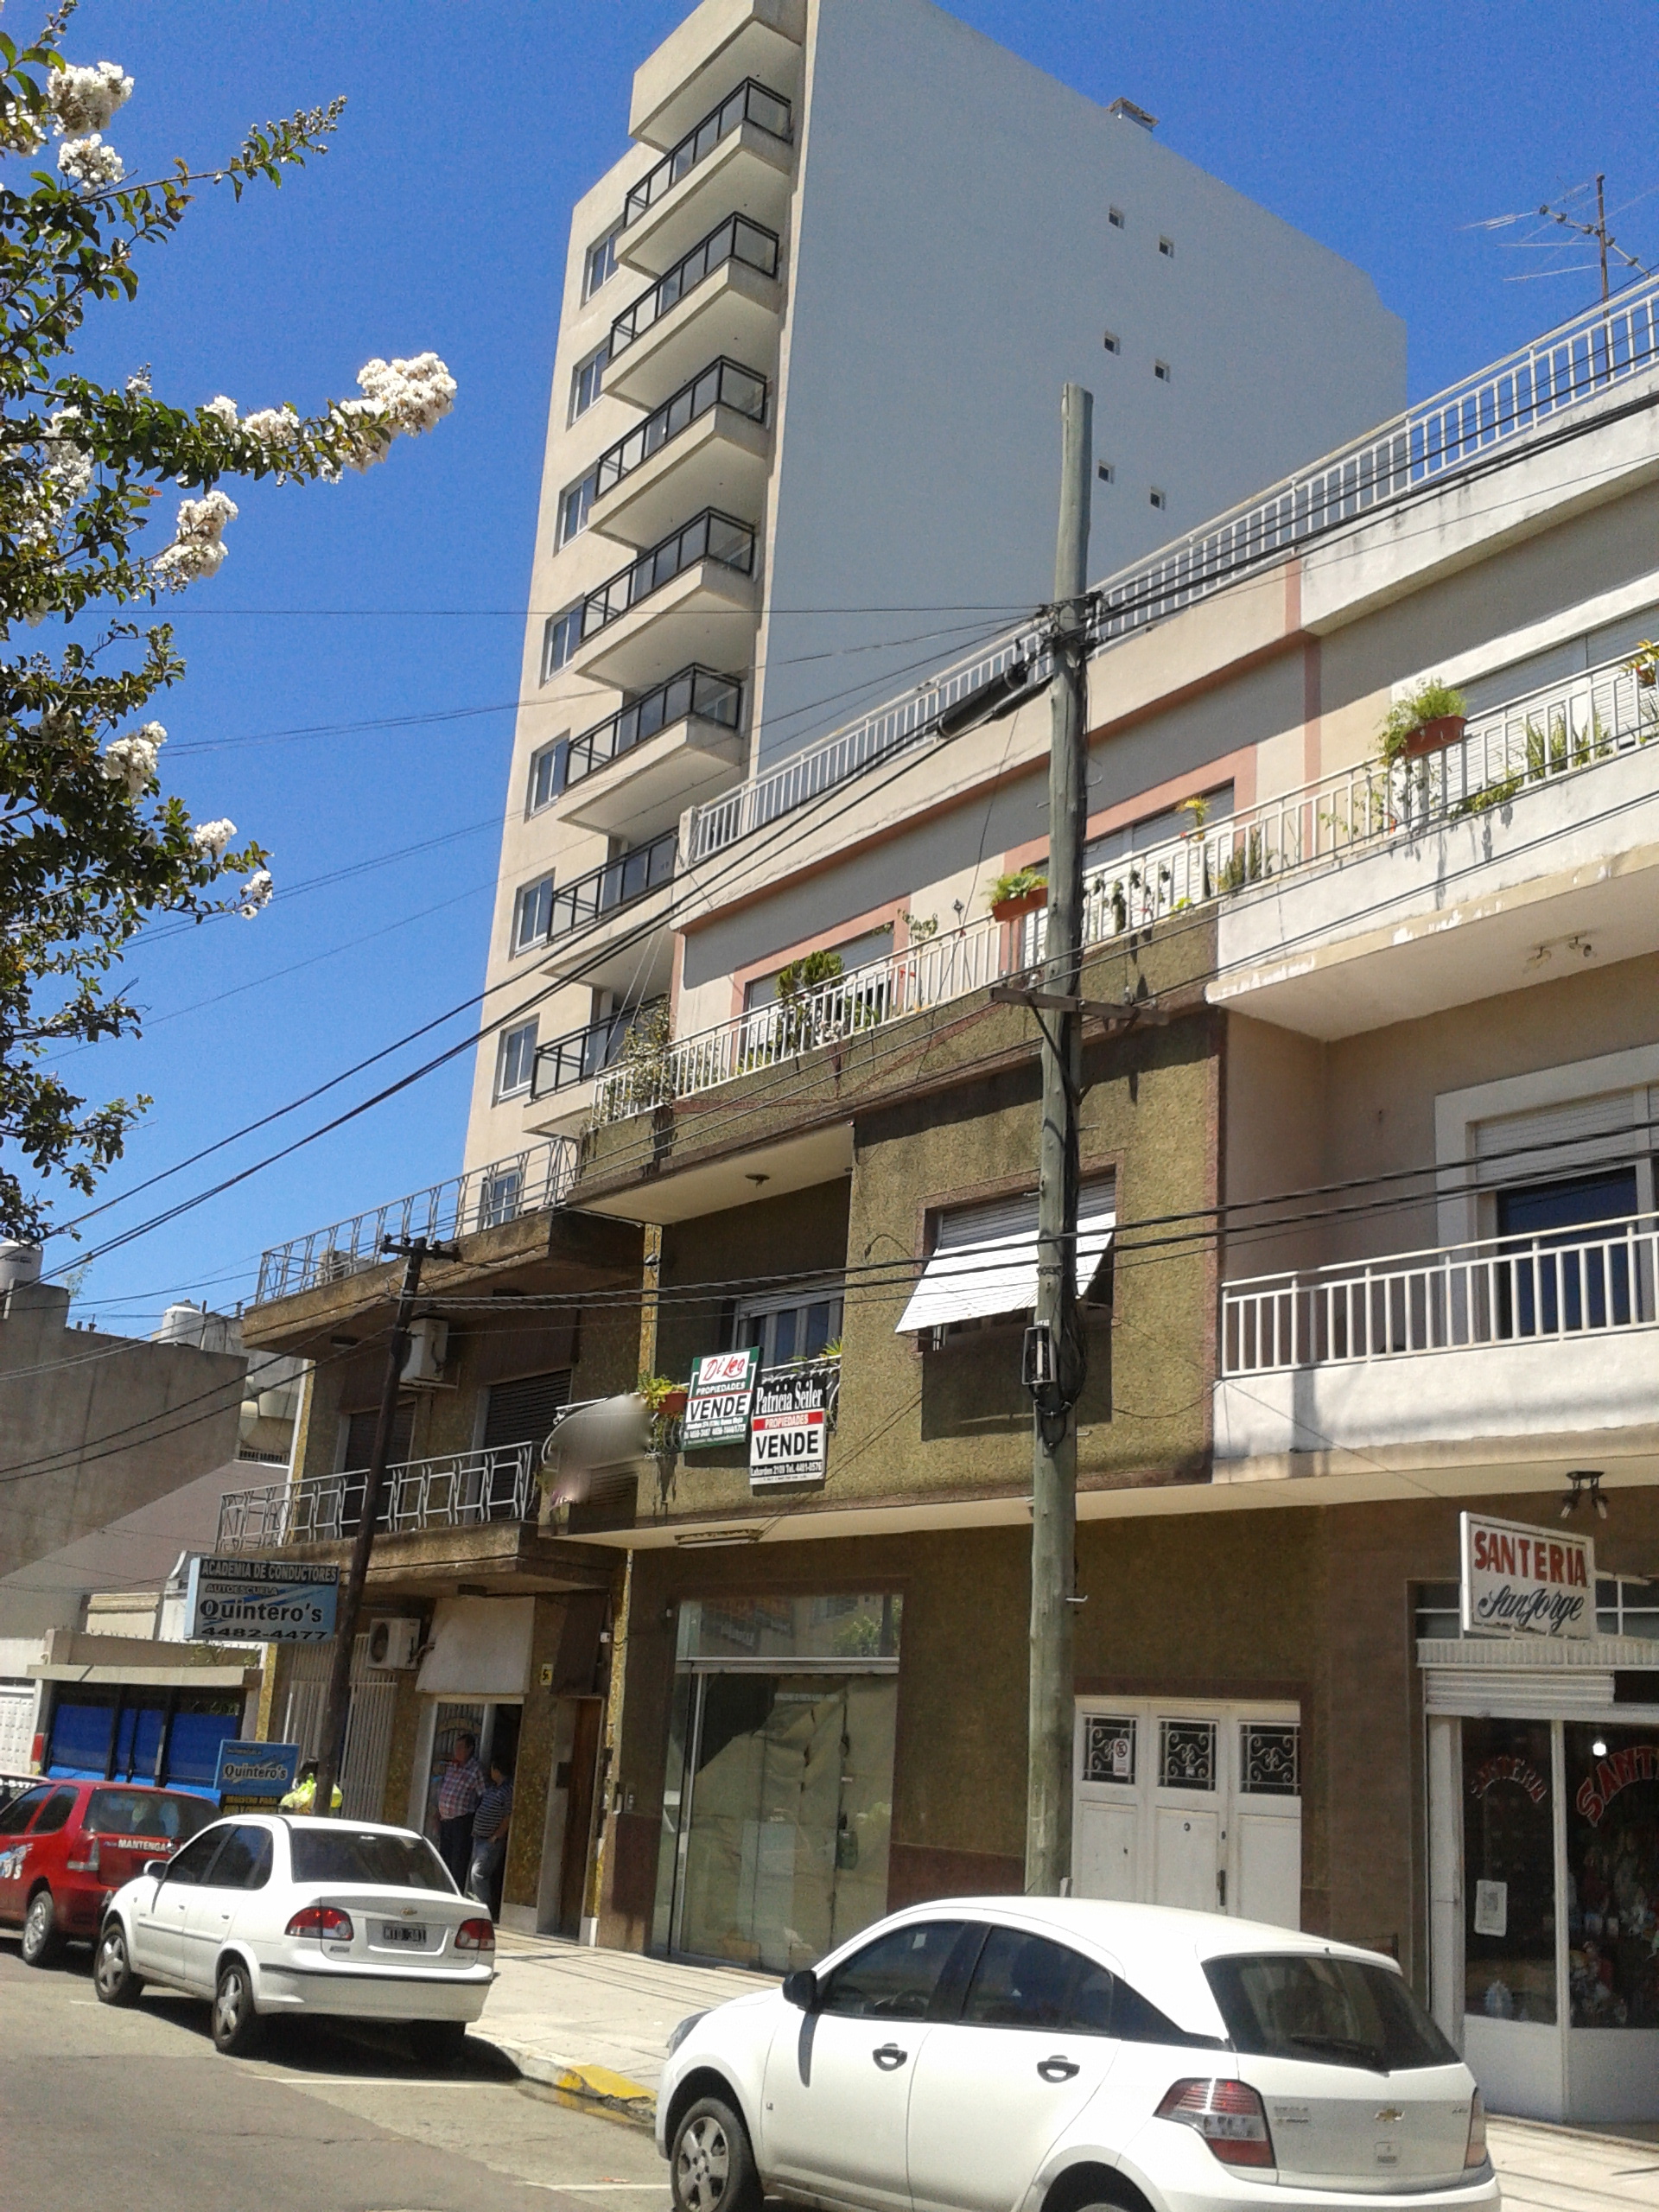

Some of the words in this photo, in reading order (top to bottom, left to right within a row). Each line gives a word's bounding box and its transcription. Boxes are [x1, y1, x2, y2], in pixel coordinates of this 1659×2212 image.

[696, 1382, 746, 1396] PROPIEDADES
[756, 1383, 792, 1415] Patricia
[795, 1379, 823, 1410] Seiler
[690, 1395, 747, 1421] VENDE
[765, 1414, 809, 1428] PROPIEDADES
[756, 1430, 818, 1459] VENDE
[1474, 1530, 1587, 1587] SANTERIA
[201, 1560, 251, 1578] ACADEMIA
[254, 1565, 267, 1580] DE
[269, 1565, 337, 1583] CONDUCTORES
[206, 1584, 279, 1596] AUTOESCUELA
[200, 1599, 323, 1623] Quintero's
[201, 1627, 327, 1640] 4482-4477
[225, 1764, 287, 1780] Quintero's
[1576, 1745, 1659, 1827] SANT
[118, 1839, 167, 1852] MANTENGA
